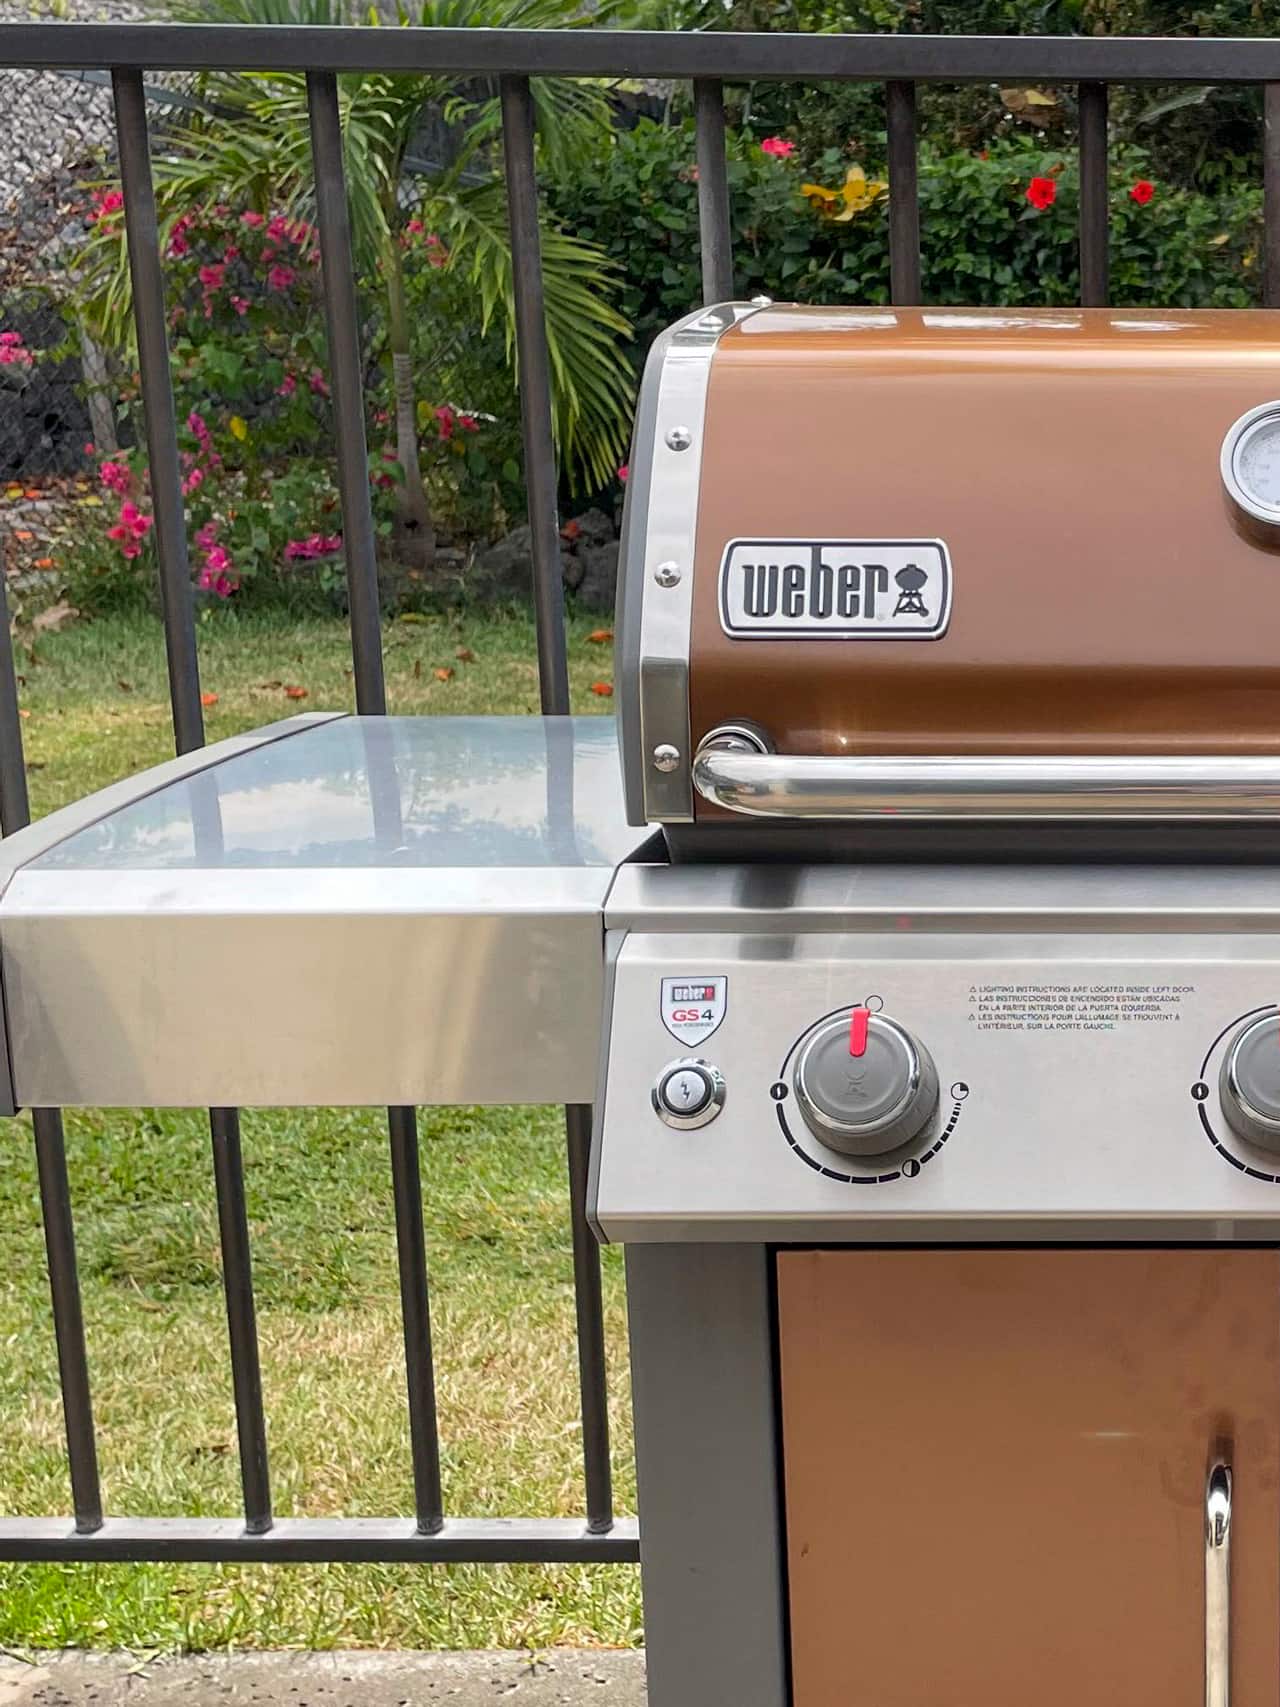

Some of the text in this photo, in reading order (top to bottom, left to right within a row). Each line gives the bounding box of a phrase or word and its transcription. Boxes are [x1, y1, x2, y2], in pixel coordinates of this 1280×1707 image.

[741, 547, 889, 619] weber
[1027, 1022, 1042, 1030] SUR
[1044, 1022, 1055, 1030] LA
[1056, 1022, 1081, 1030] PORTE
